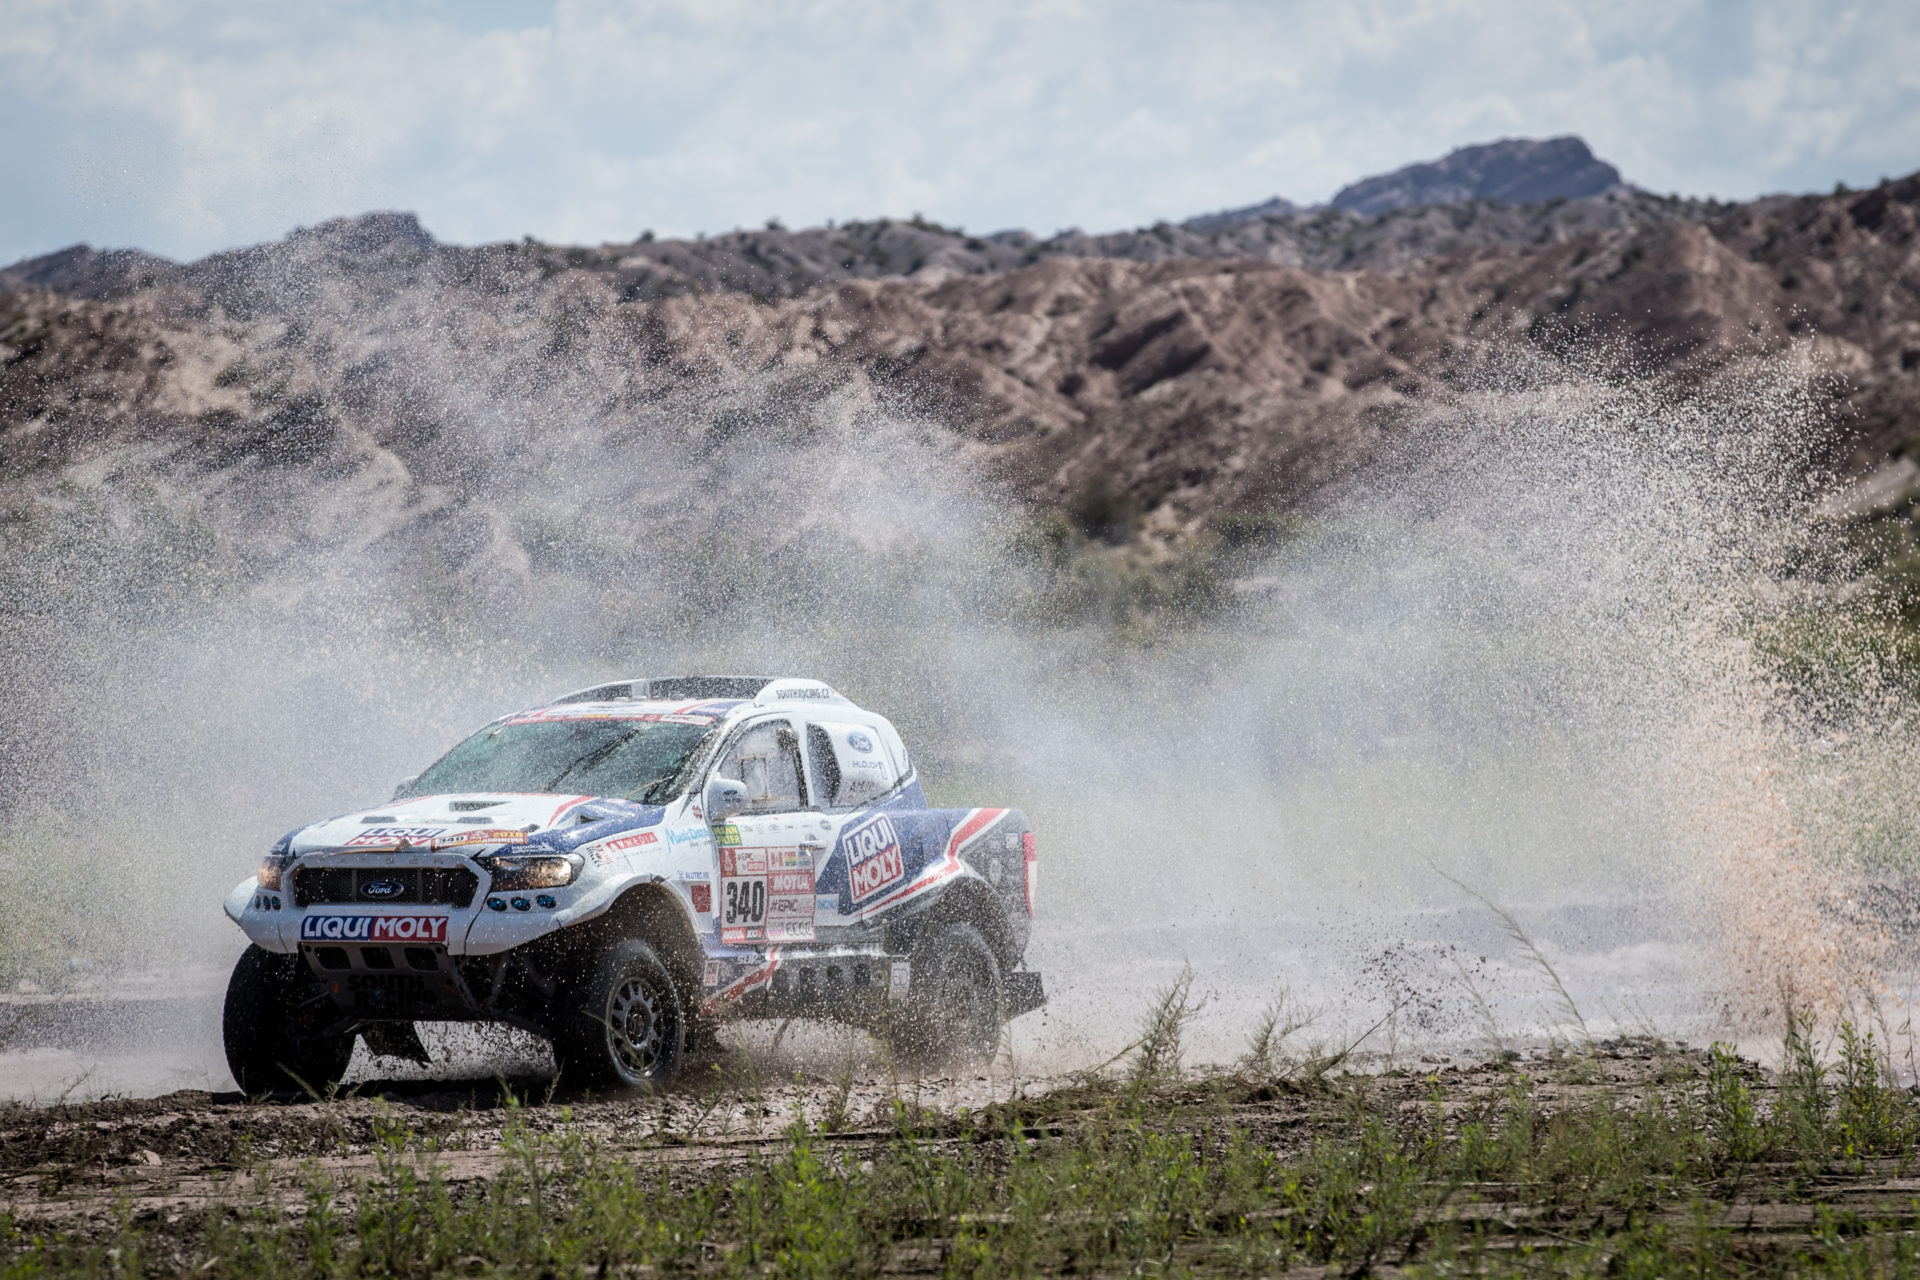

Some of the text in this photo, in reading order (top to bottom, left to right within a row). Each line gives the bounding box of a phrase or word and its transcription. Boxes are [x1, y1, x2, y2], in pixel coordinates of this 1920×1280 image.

[366, 828, 443, 837] LIQUI
[846, 818, 894, 864] LIQUI
[852, 848, 899, 896] MOLY
[367, 879, 393, 895] Ford
[772, 875, 810, 891] MOTUL
[726, 881, 764, 924] 340
[303, 916, 448, 938] LIQUI MOLY
[347, 974, 425, 991] SOUTH
